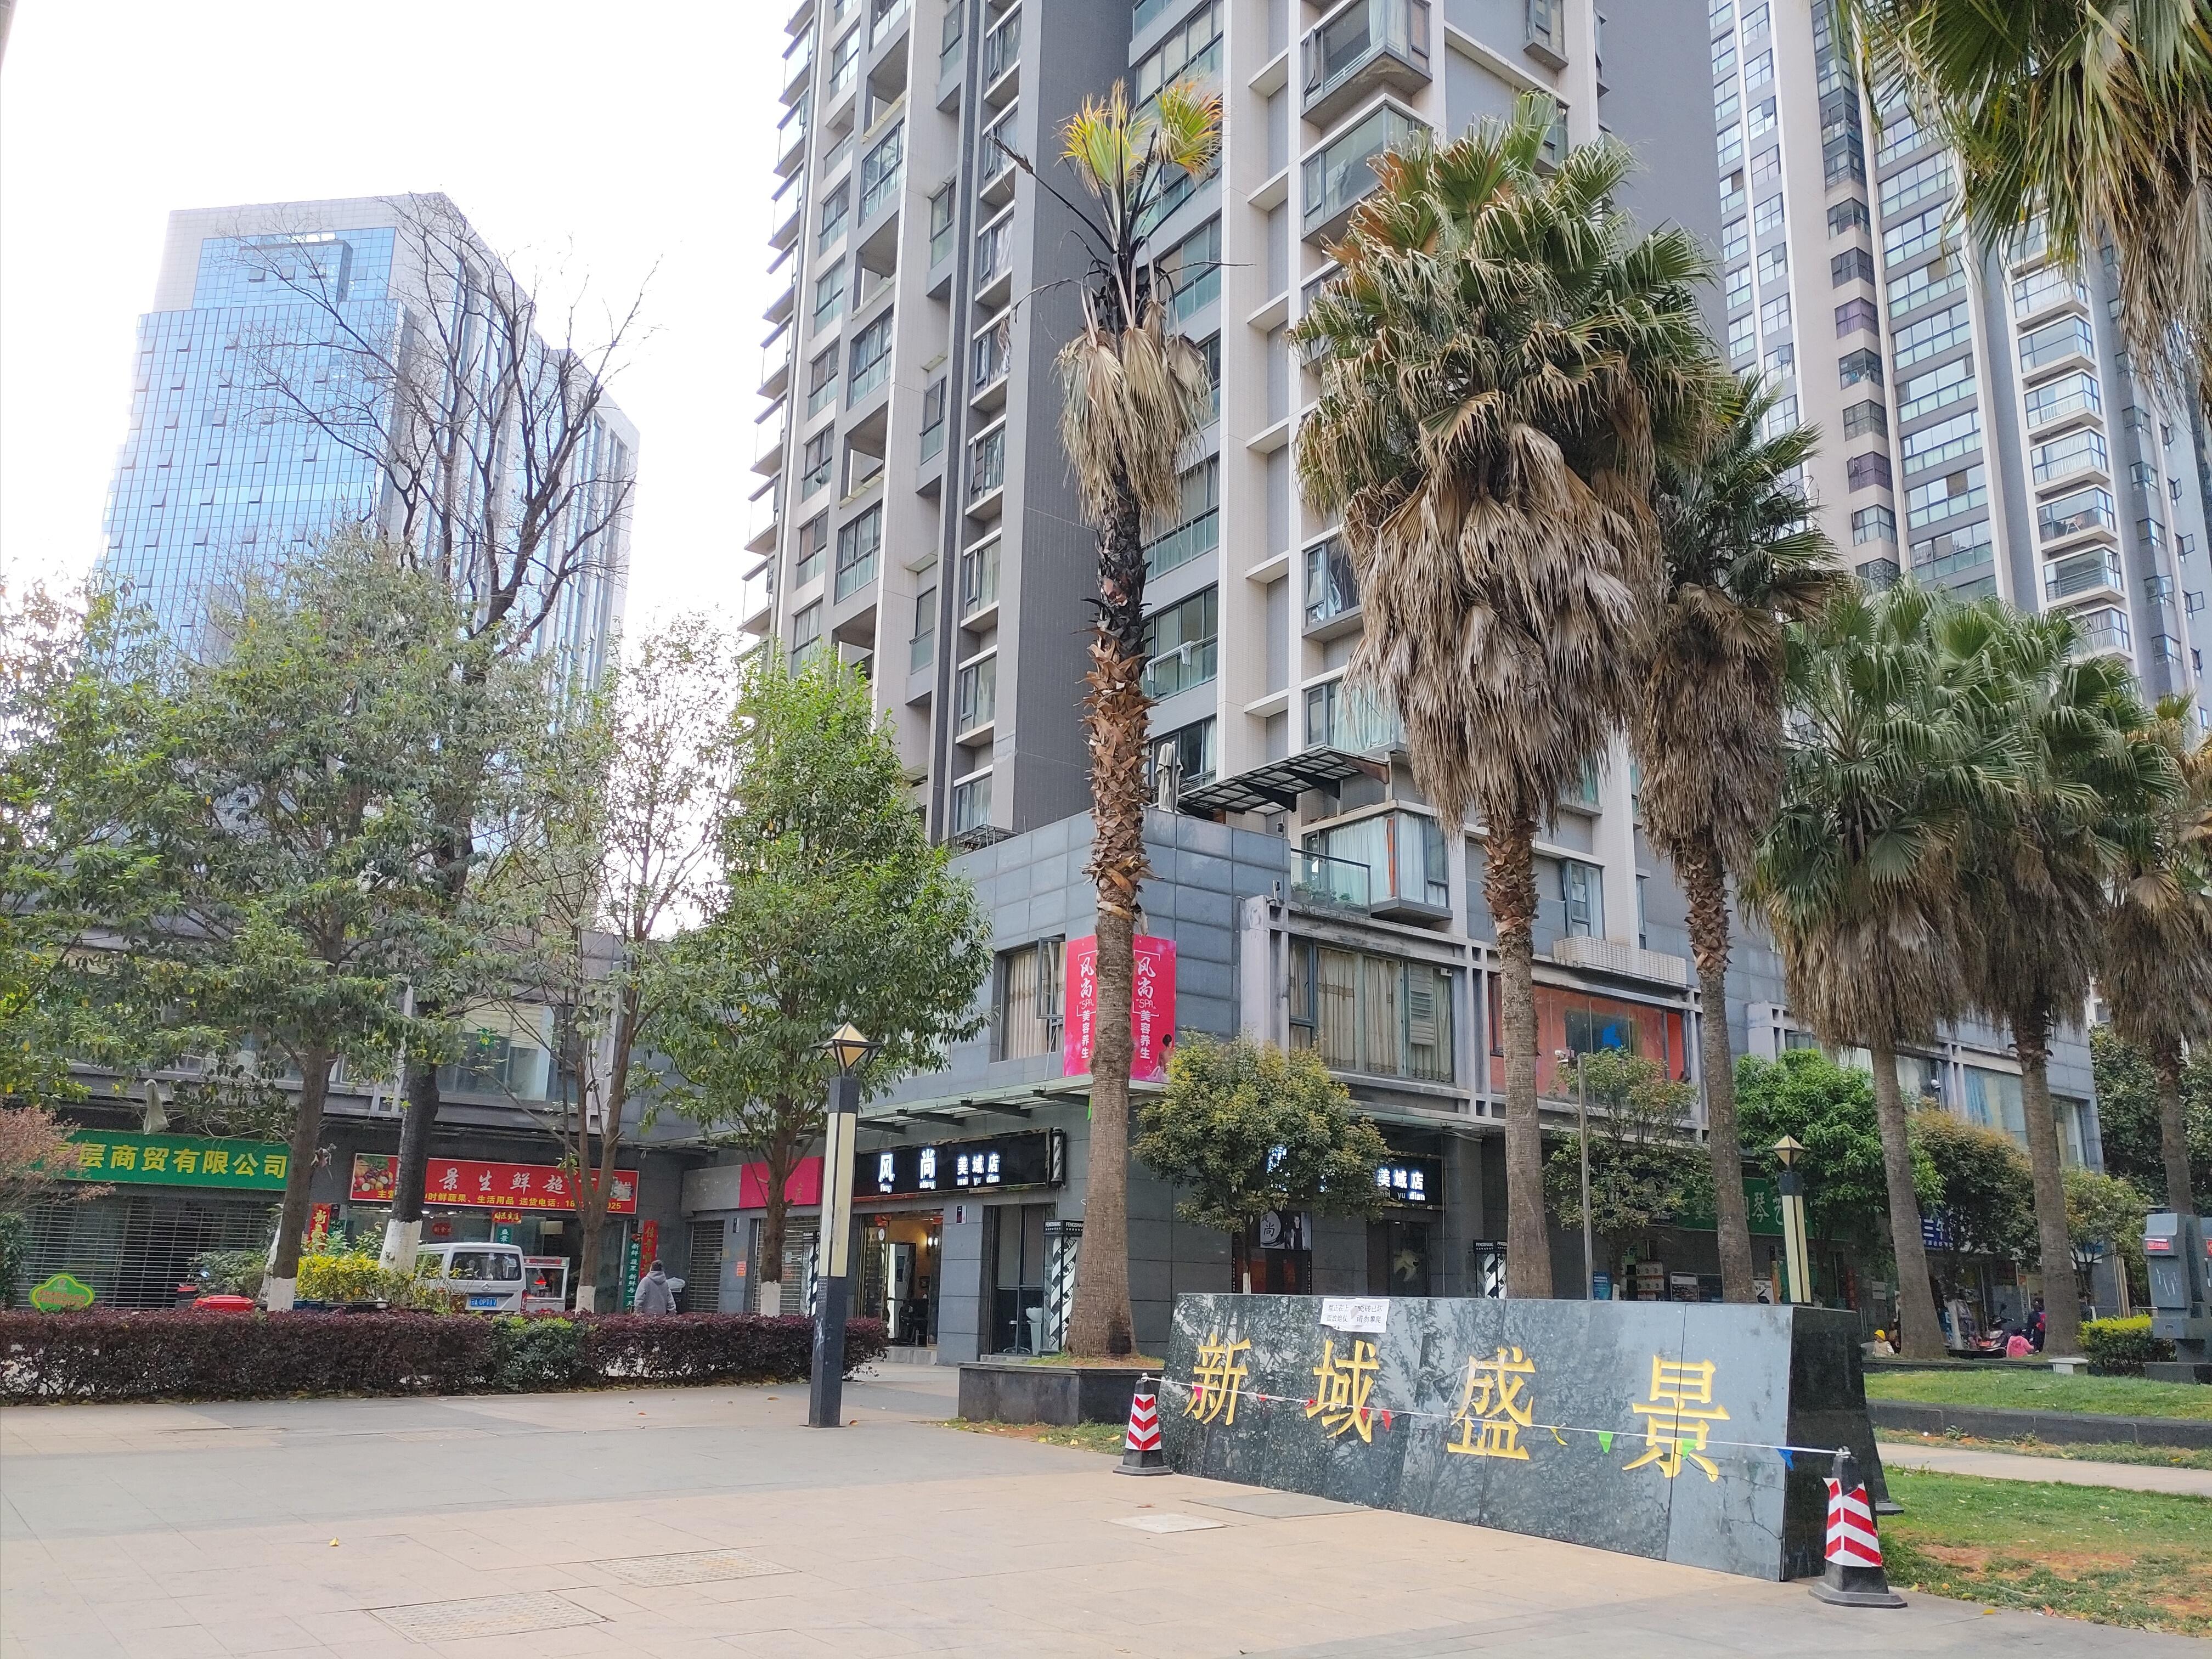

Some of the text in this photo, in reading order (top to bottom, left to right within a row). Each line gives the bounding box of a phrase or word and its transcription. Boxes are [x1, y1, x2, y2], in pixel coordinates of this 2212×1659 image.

[1080, 956, 1094, 999] 风尚
[1137, 956, 1156, 999] 风尚
[1081, 1000, 1093, 1010] SPA
[1138, 998, 1153, 1009] SPA
[1081, 1010, 1091, 1059] 美容养生
[1140, 1010, 1151, 1059] 美容养生
[438, 1167, 597, 1195] 景生鲜超
[878, 1148, 1000, 1183] 风尚 美域店
[425, 1192, 514, 1206] 时鲜蔬果、生活用品
[1408, 1190, 1425, 1200] dian
[1182, 1333, 1730, 1482] 新域盛景
